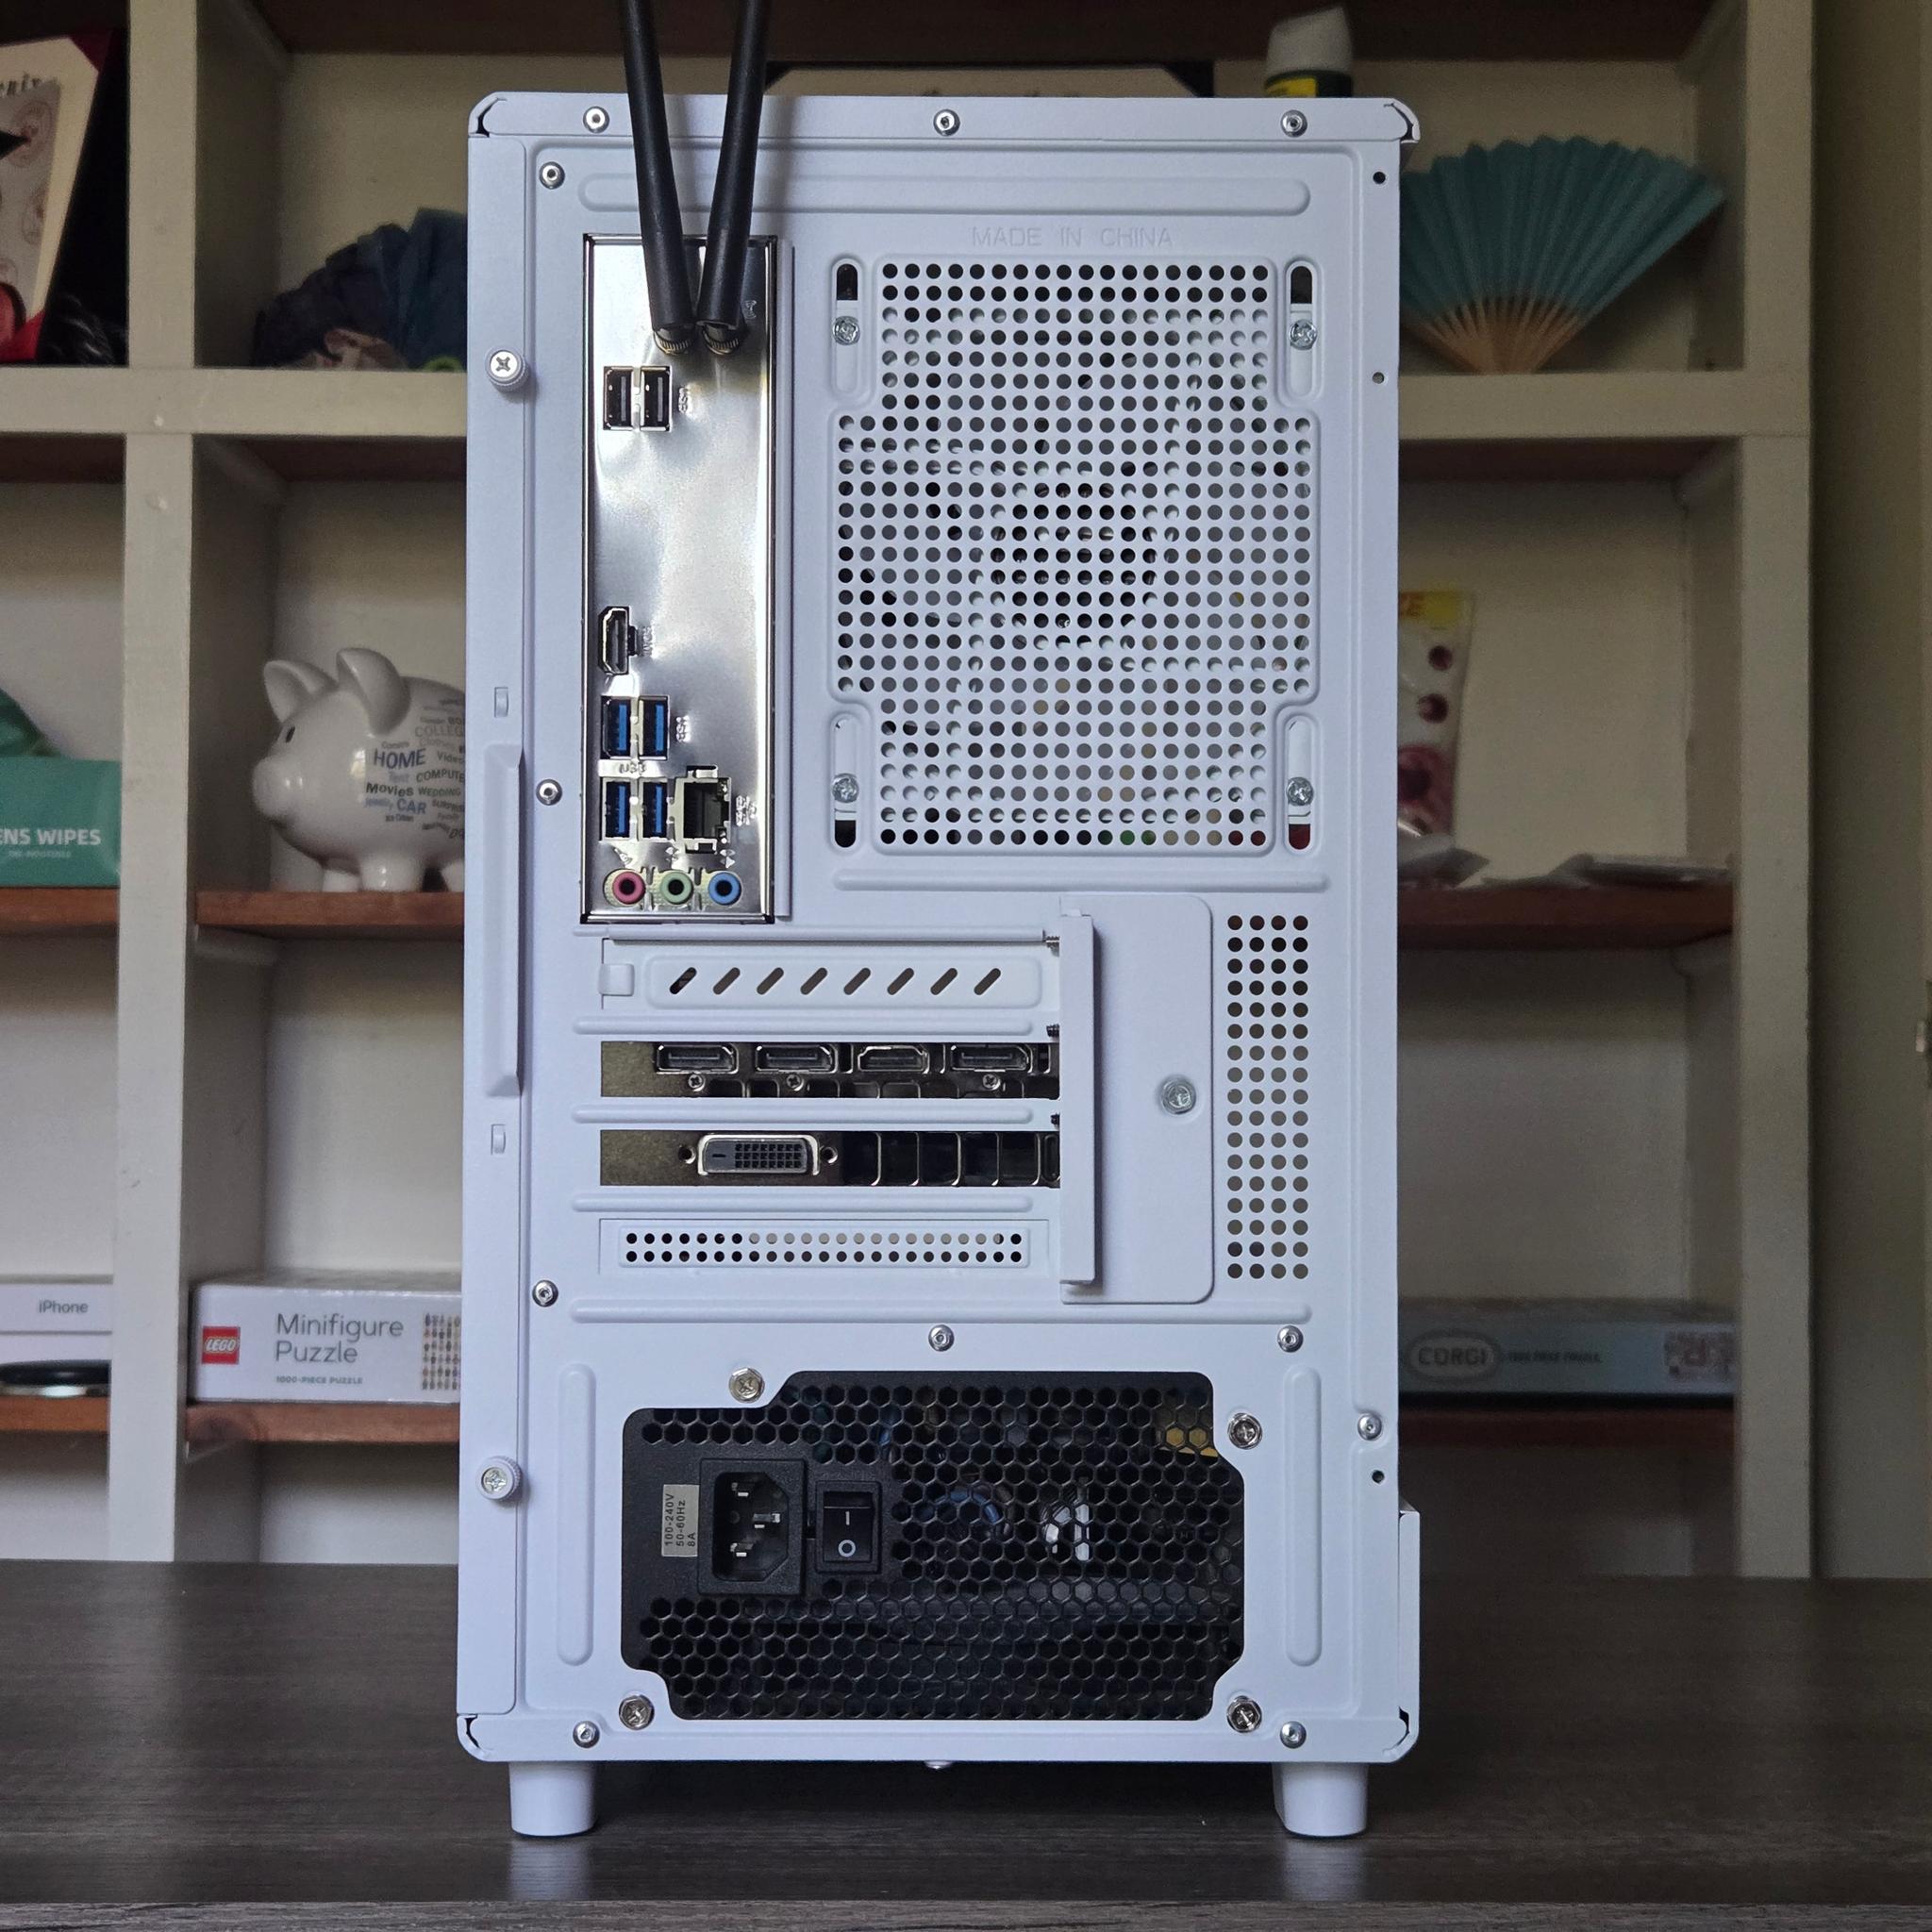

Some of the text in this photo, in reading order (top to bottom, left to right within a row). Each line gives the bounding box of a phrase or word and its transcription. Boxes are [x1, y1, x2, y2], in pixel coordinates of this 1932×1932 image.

[972, 226, 1174, 247] MADE IN CHINA
[374, 748, 427, 770] HOME
[365, 781, 414, 797] Movies
[396, 798, 427, 815] CAR
[37, 828, 102, 846] WIPES
[38, 1299, 89, 1314] iPhone
[276, 1313, 405, 1343] Minifigure
[204, 1337, 238, 1354] LEGO
[275, 1340, 359, 1364] Puzzle
[1418, 1346, 1488, 1366] CORGI
[664, 1492, 675, 1547] 100-240V
[675, 1499, 686, 1547] 50-60Hz
[687, 1531, 696, 1547] 8A
